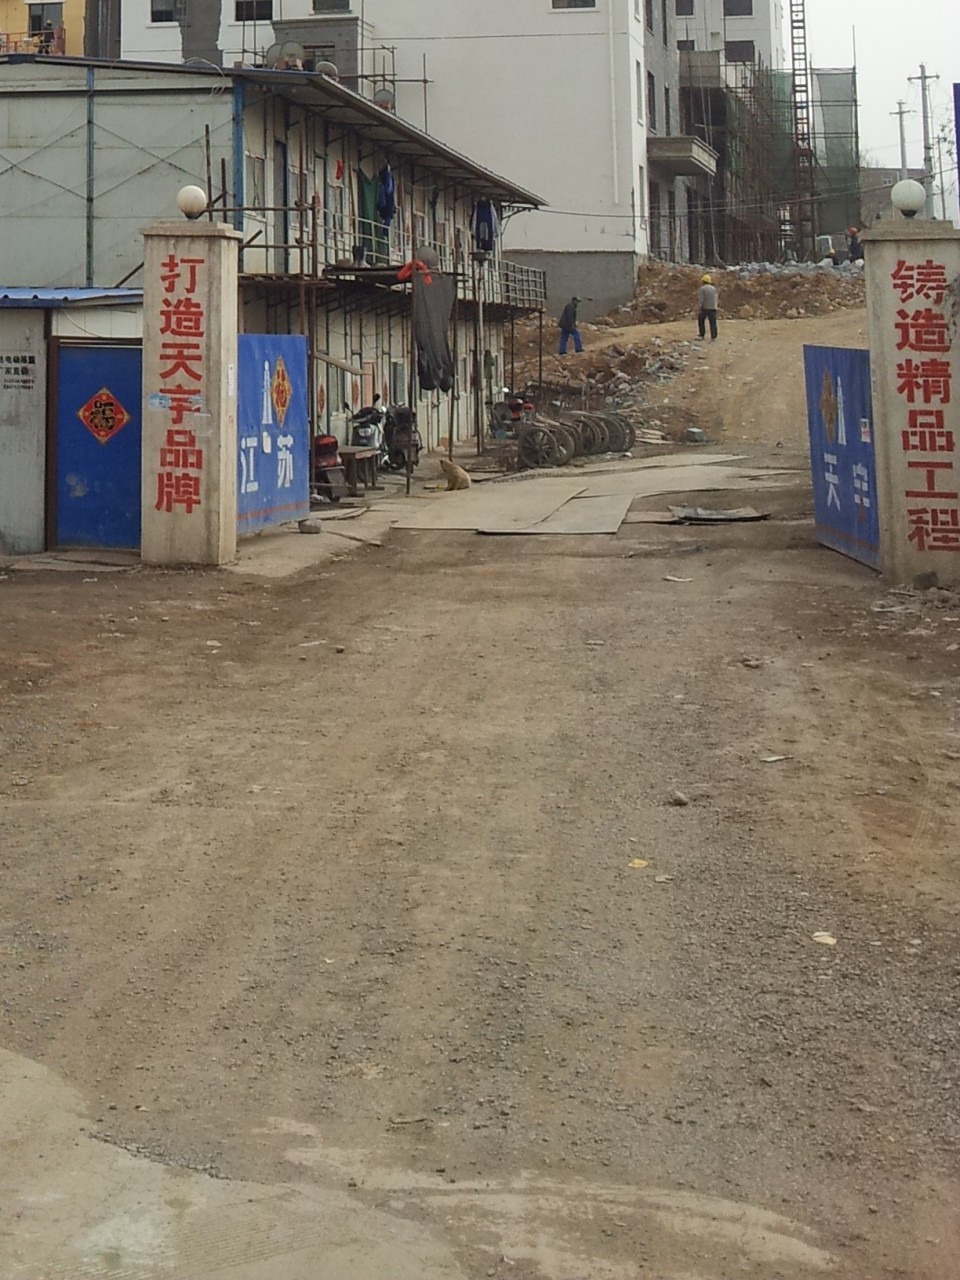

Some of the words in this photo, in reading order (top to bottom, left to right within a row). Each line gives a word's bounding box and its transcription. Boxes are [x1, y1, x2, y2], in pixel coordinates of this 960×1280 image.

[154, 254, 205, 514] 打造天宇品牌
[891, 259, 960, 552] 铸造精品工程
